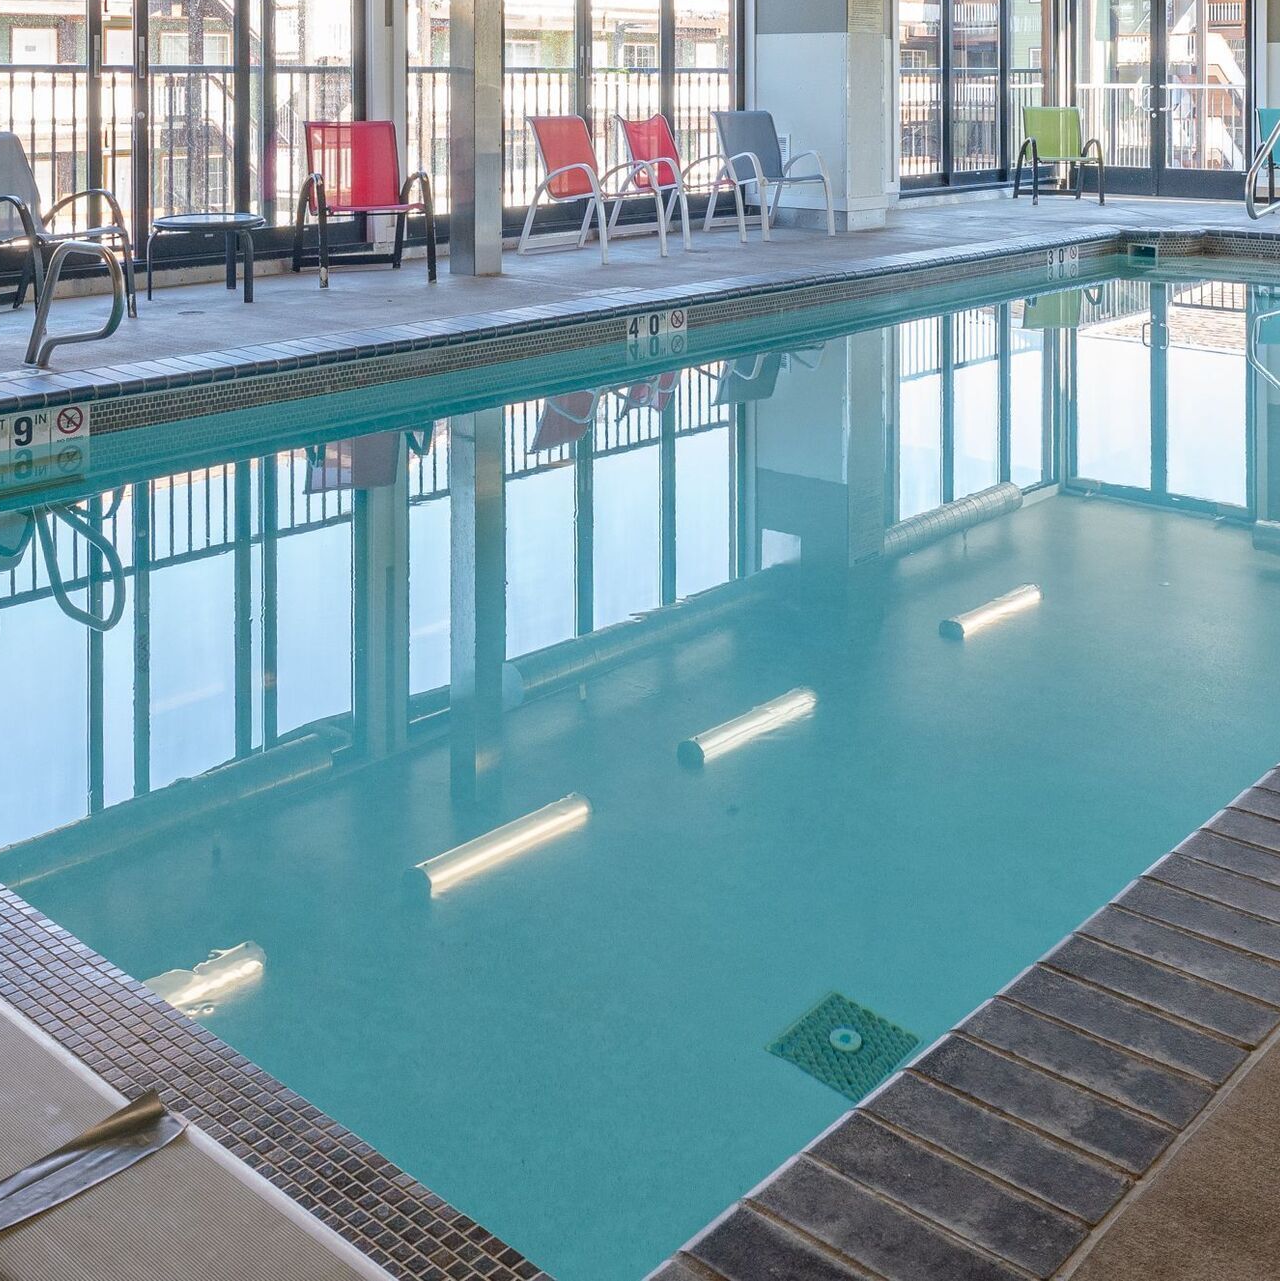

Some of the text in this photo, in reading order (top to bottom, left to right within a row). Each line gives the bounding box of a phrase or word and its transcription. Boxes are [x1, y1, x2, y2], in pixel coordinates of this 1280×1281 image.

[1048, 248, 1064, 265] 3 0
[629, 317, 639, 338] 4
[639, 315, 645, 324] FT
[649, 314, 659, 336] 0
[13, 416, 33, 446] 9
[35, 413, 47, 425] IN
